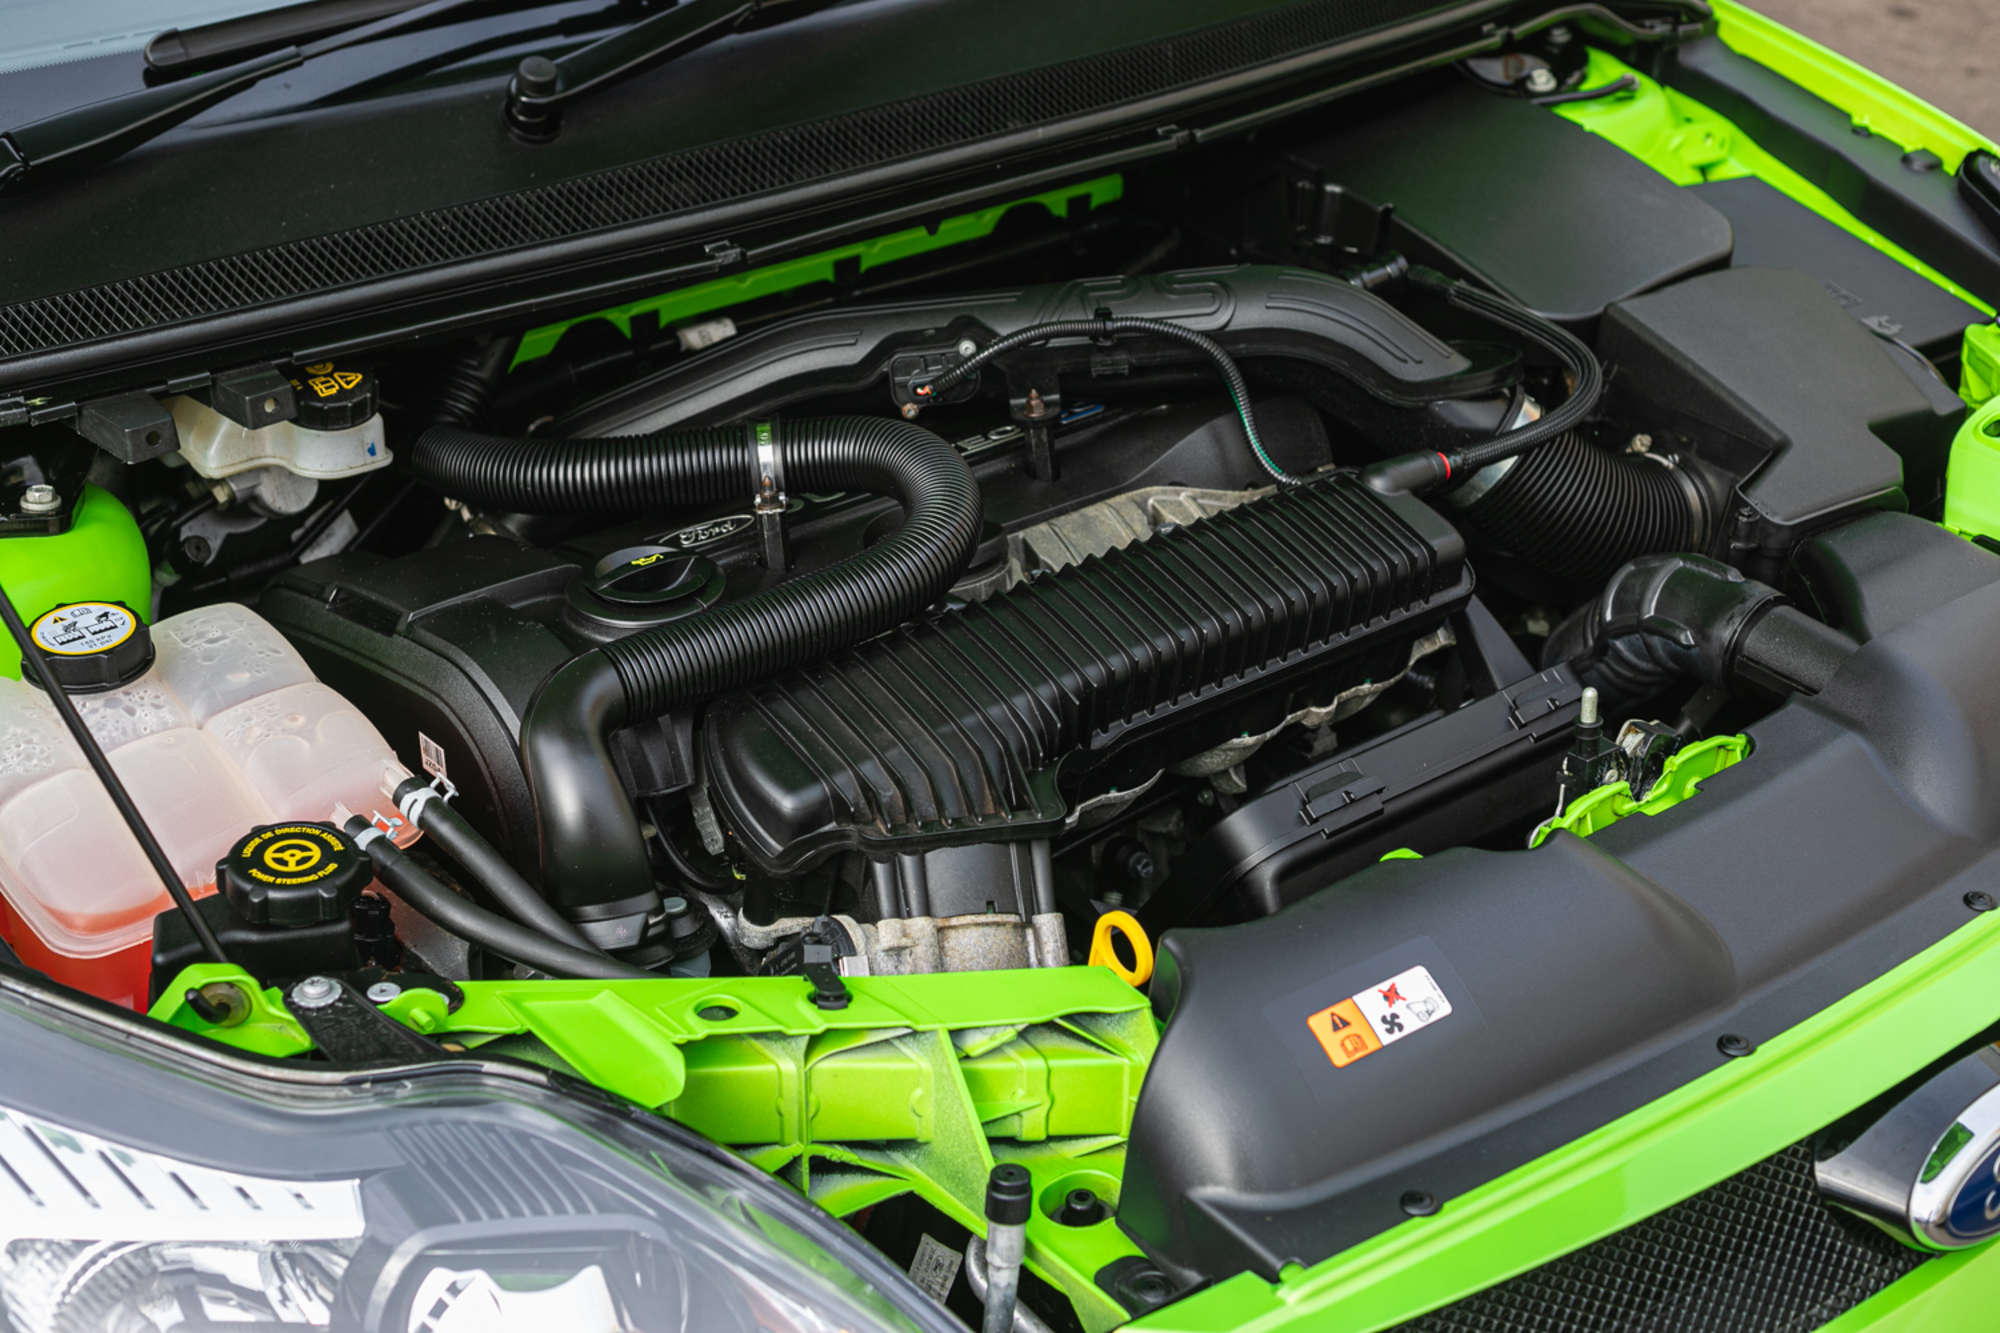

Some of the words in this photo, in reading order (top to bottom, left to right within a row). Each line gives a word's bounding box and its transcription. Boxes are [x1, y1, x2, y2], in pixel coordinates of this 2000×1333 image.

[680, 520, 737, 545] Ford
[274, 826, 322, 836] DIRECTION
[248, 868, 276, 884] POWER
[275, 874, 319, 885] STEERING
[317, 862, 339, 878] FLUID
